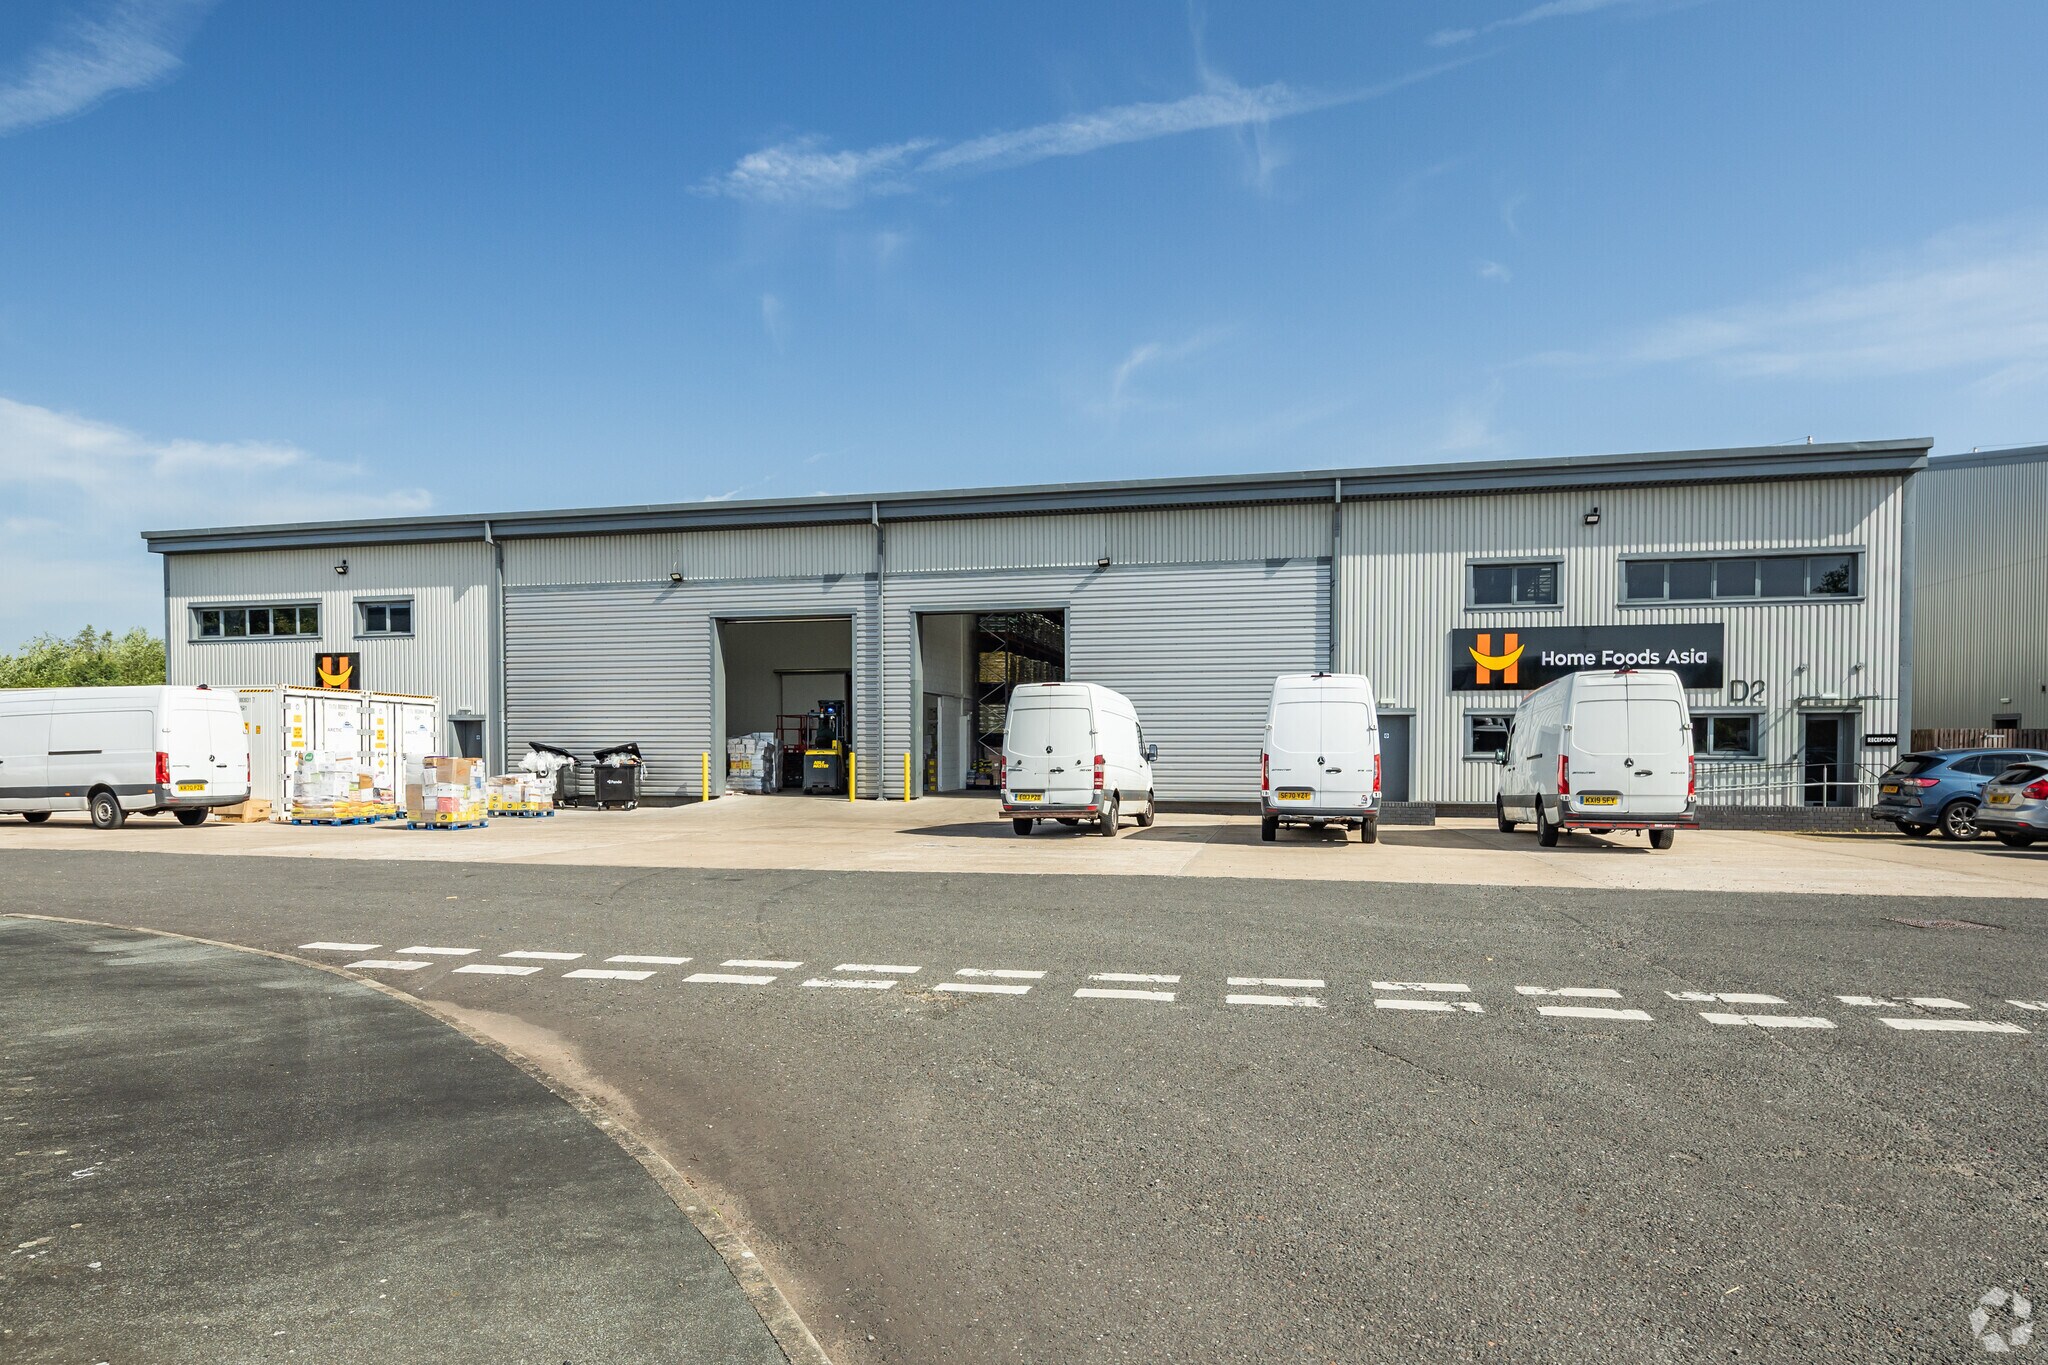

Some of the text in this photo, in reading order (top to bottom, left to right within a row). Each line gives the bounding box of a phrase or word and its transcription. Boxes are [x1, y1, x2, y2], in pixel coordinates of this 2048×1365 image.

[1541, 647, 1708, 666] Home Foods Asia
[1730, 680, 1766, 702] D2
[1585, 796, 1600, 804] KX19
